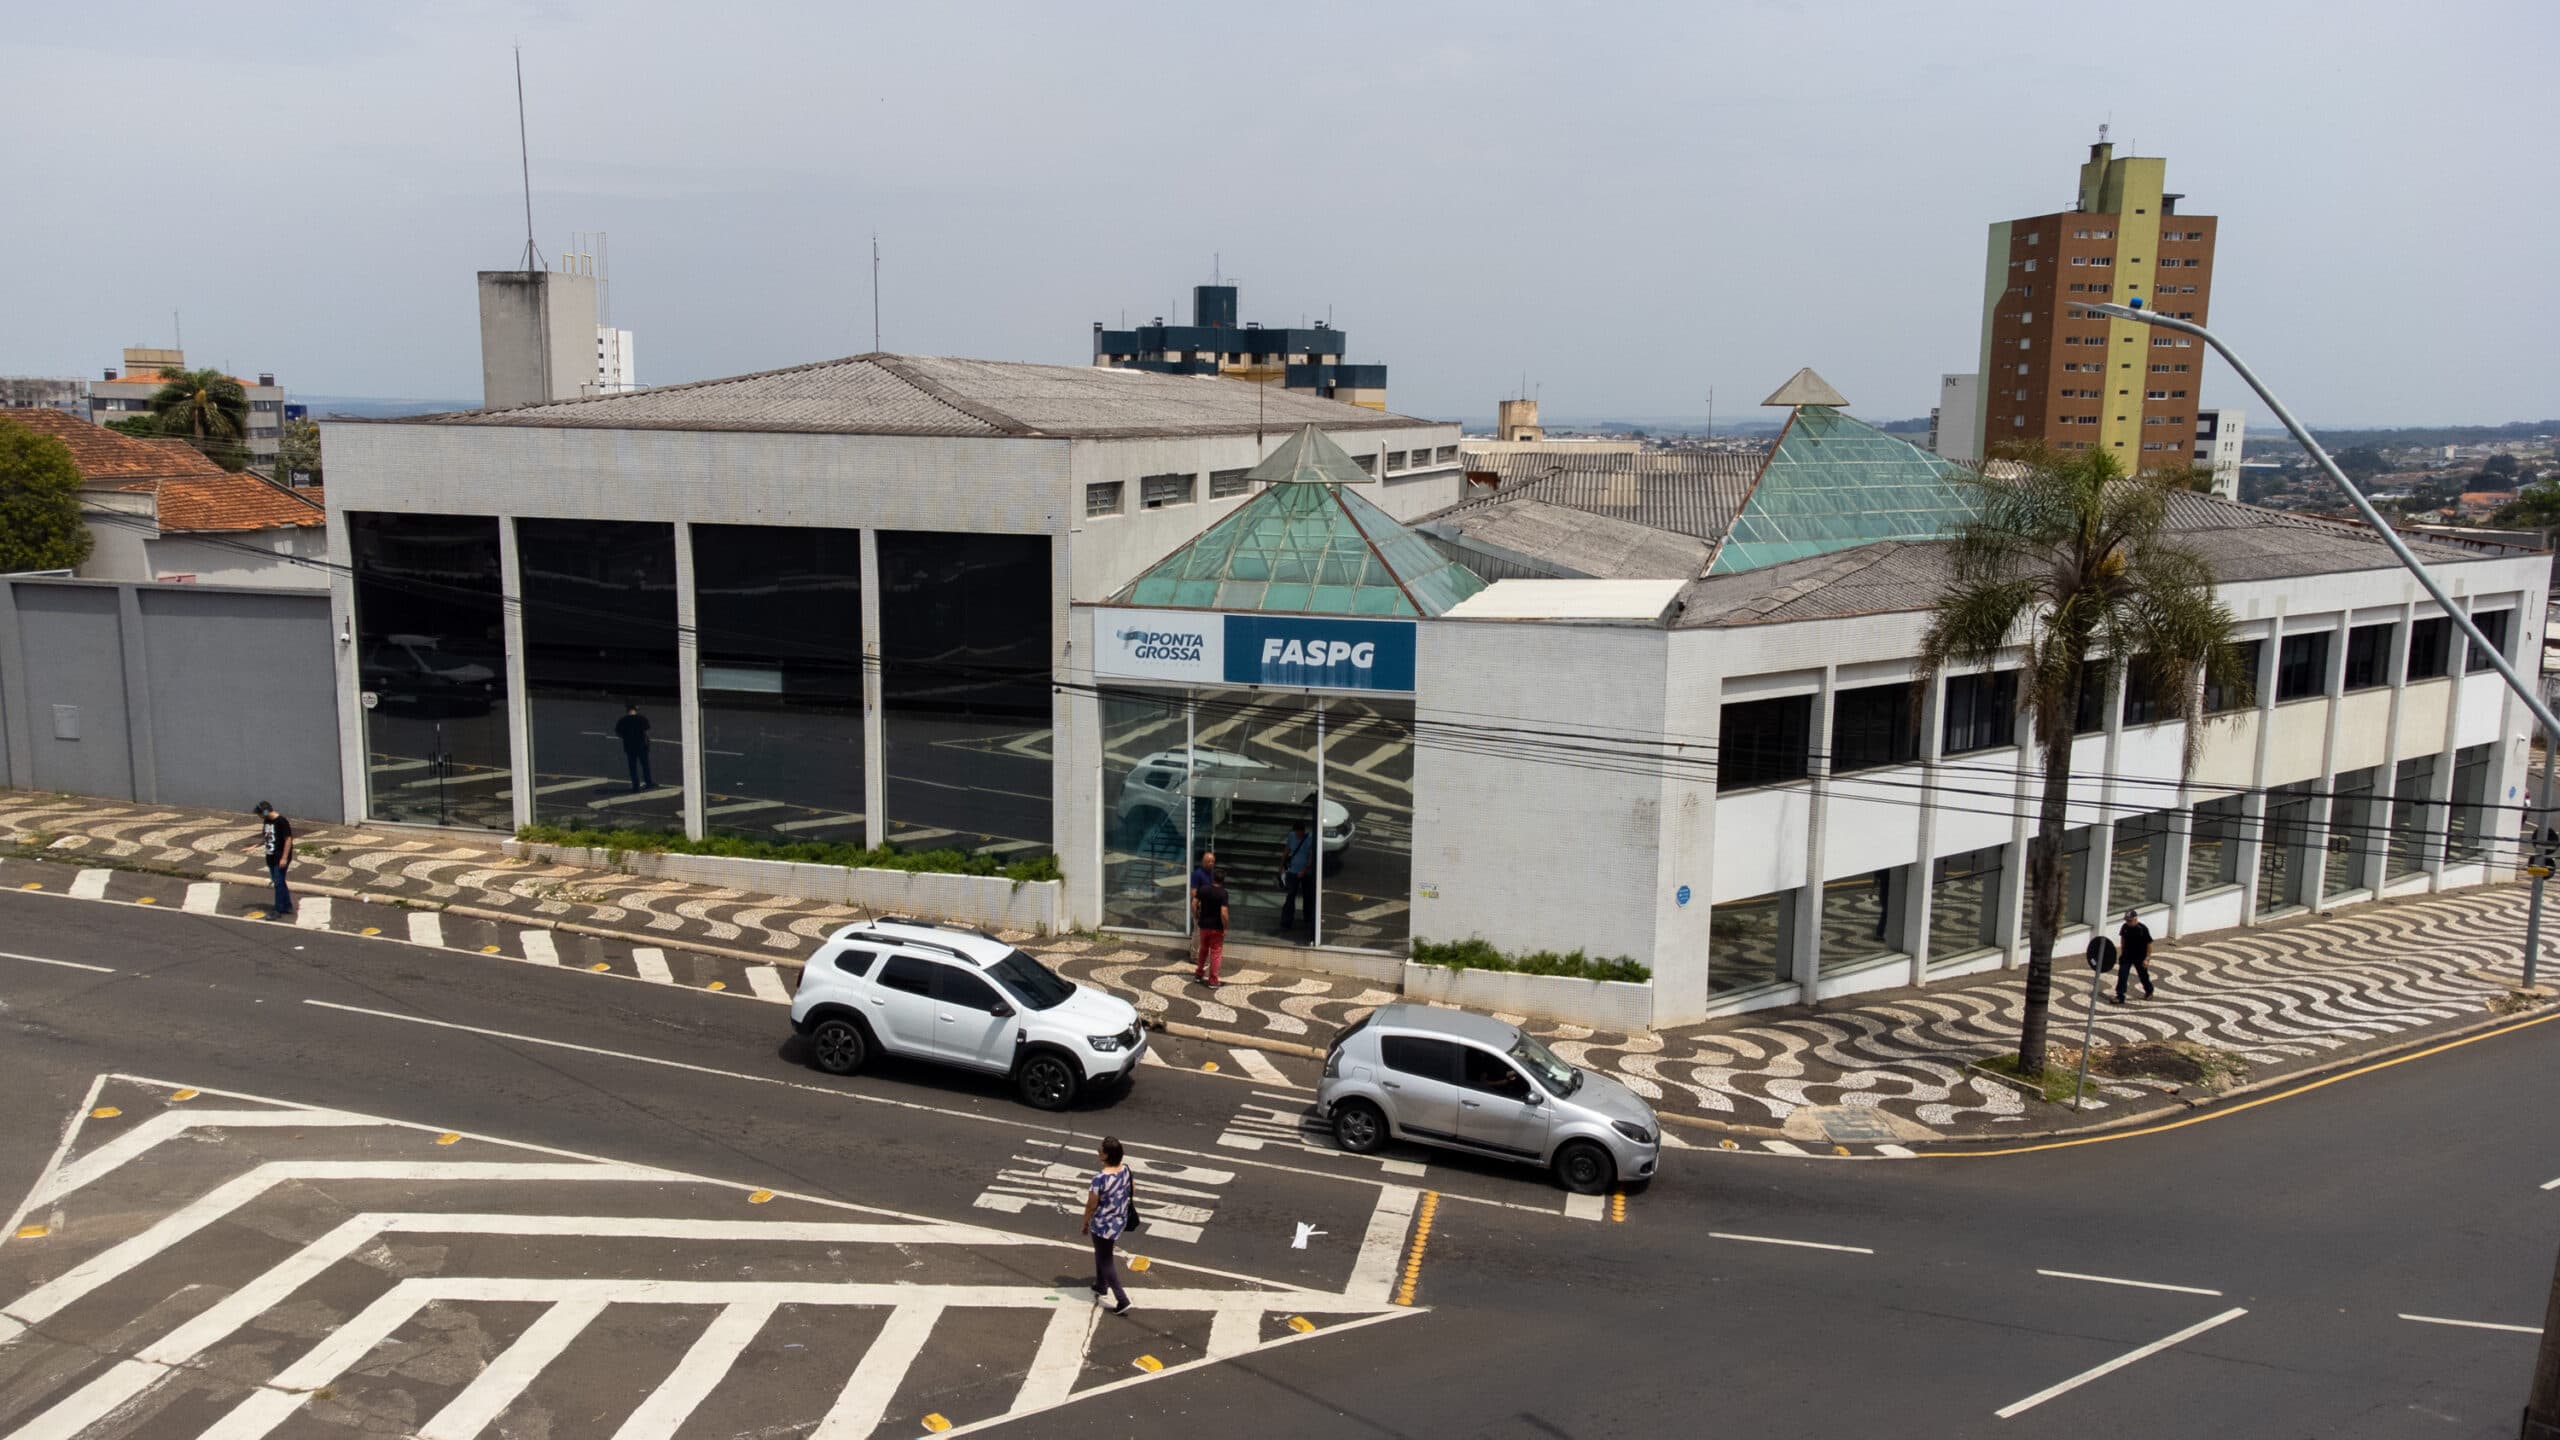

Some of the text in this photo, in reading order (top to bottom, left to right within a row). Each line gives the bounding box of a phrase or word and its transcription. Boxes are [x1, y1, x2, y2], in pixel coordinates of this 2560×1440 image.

[1148, 632, 1204, 648] PONTA
[1135, 645, 1201, 662] GROSSA
[1261, 638, 1375, 669] FASPG
